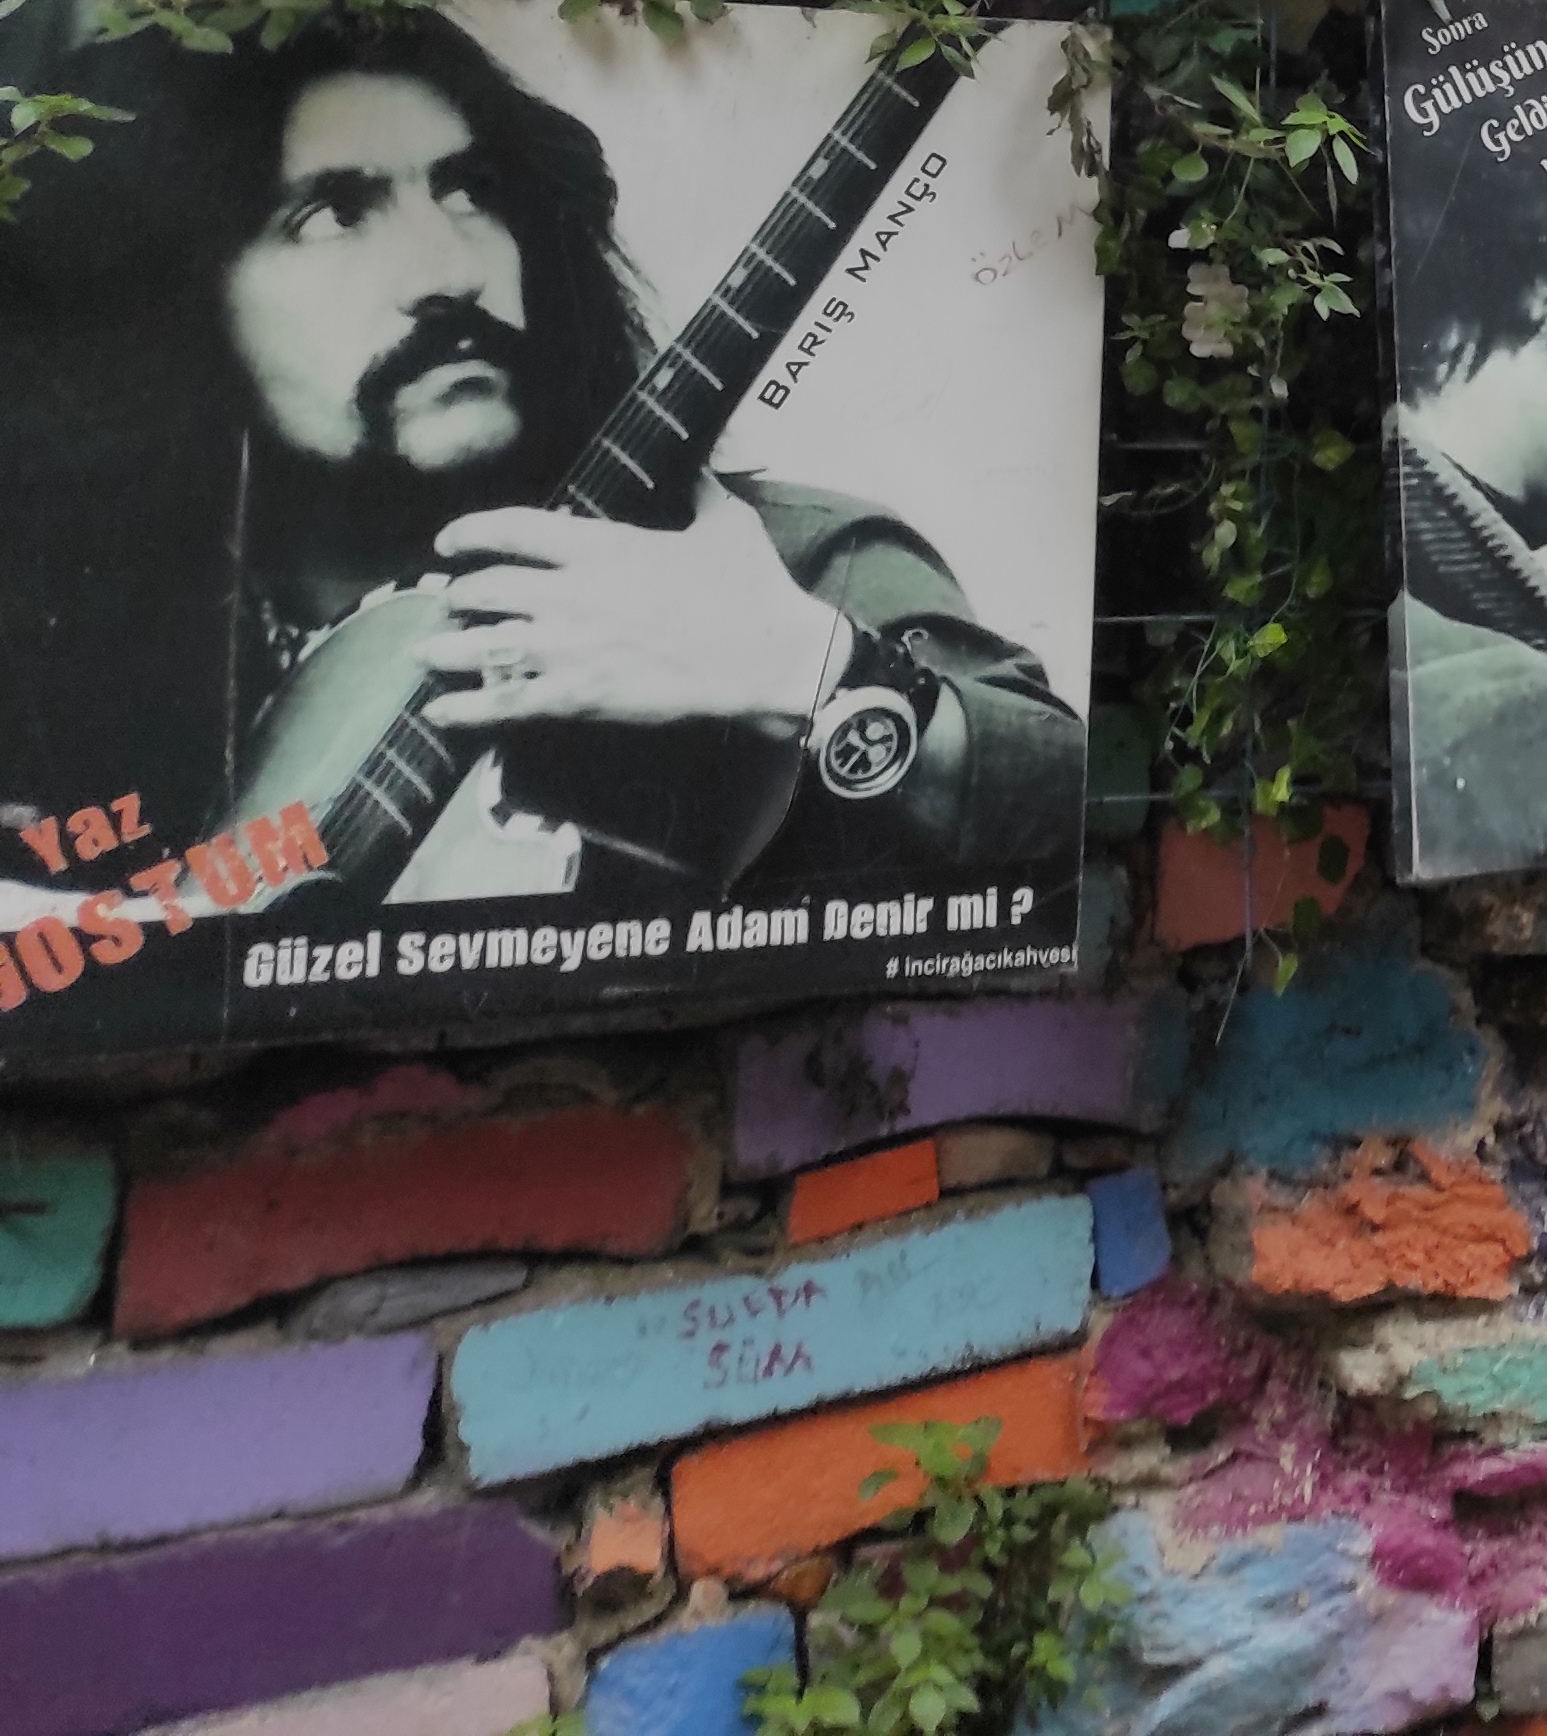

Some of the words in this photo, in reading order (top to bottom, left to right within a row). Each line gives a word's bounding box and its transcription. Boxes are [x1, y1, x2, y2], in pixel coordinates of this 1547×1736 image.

[1420, 8, 1489, 56] Sonra
[758, 296, 856, 410] BARIŞ
[845, 152, 948, 283] MANÇO
[19, 791, 153, 875] Yaz
[243, 929, 383, 989] Güzel
[396, 917, 673, 983] Sevmeyene
[686, 897, 811, 955] Adam
[823, 886, 932, 942] Denir
[945, 885, 999, 931] mi
